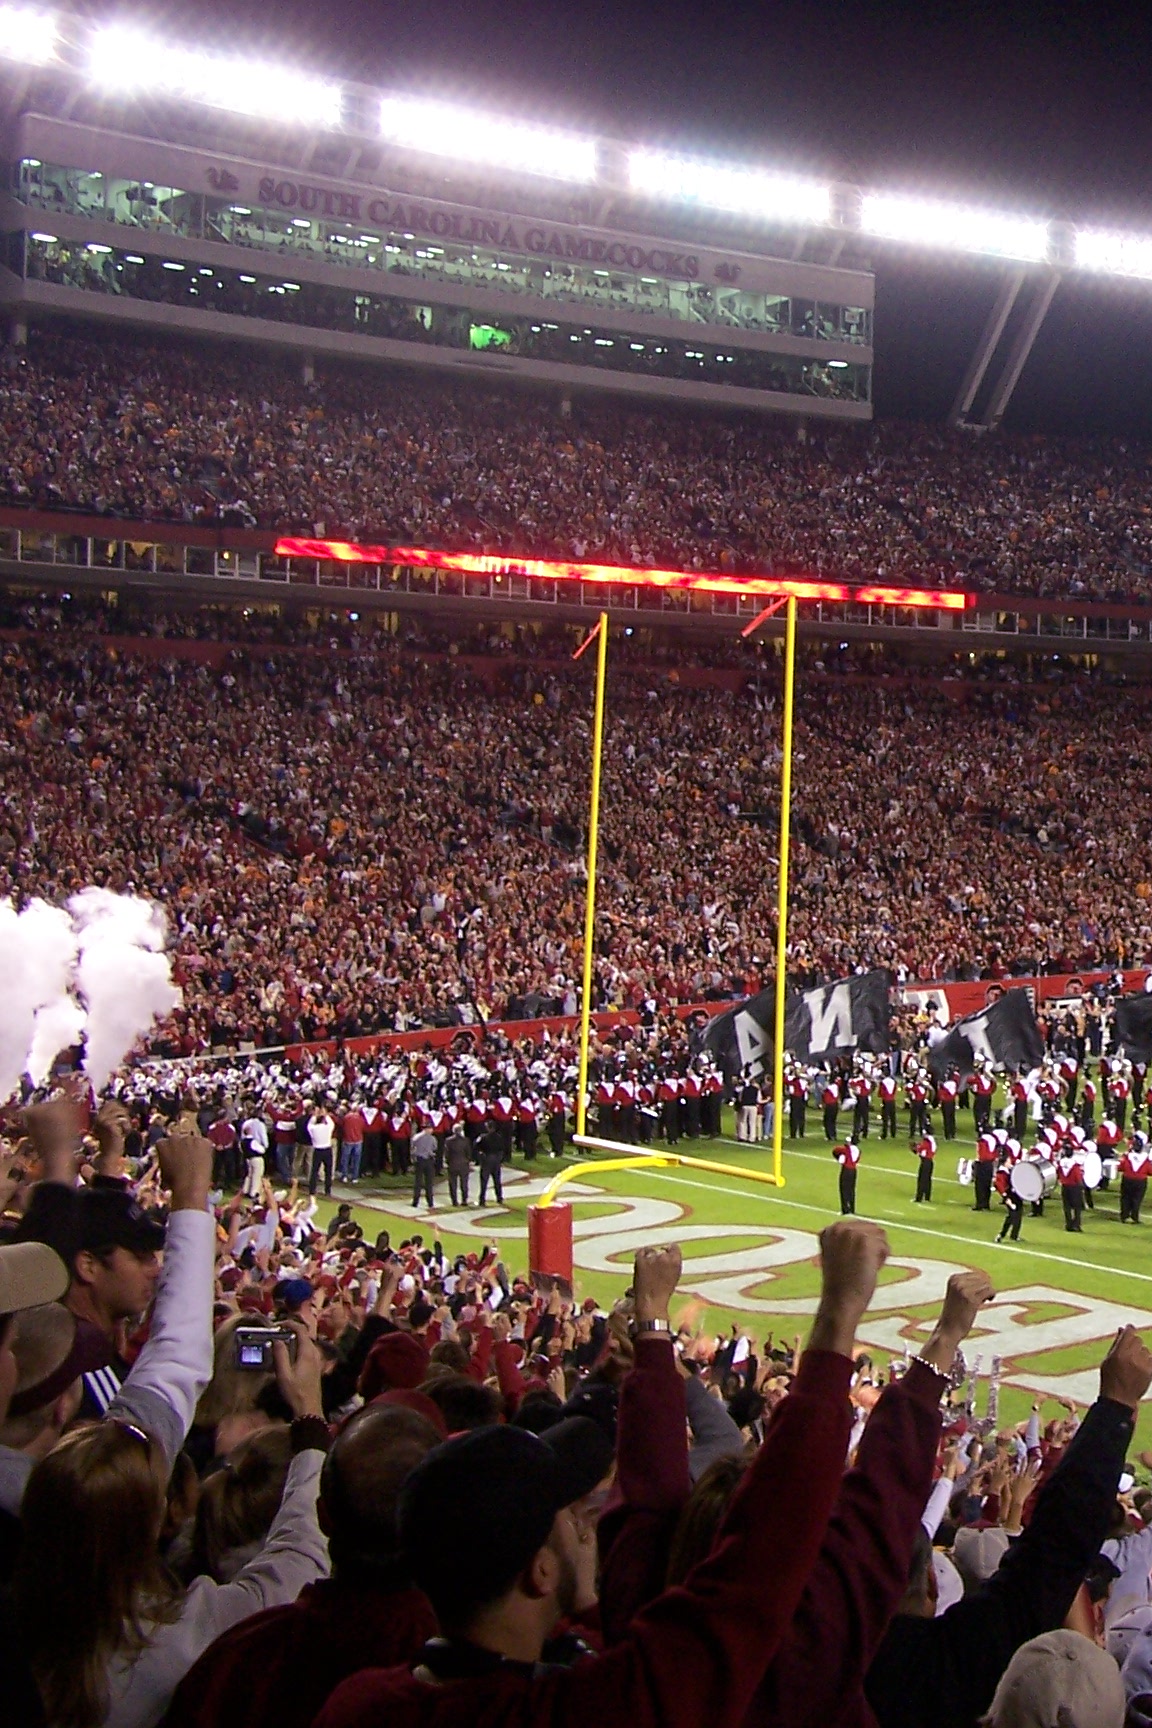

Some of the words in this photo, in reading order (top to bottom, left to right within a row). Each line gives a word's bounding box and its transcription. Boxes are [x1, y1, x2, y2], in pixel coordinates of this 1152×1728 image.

[258, 177, 362, 220] SOUTH
[367, 200, 520, 250] CAROLINA
[524, 228, 700, 279] GAMECOCKS
